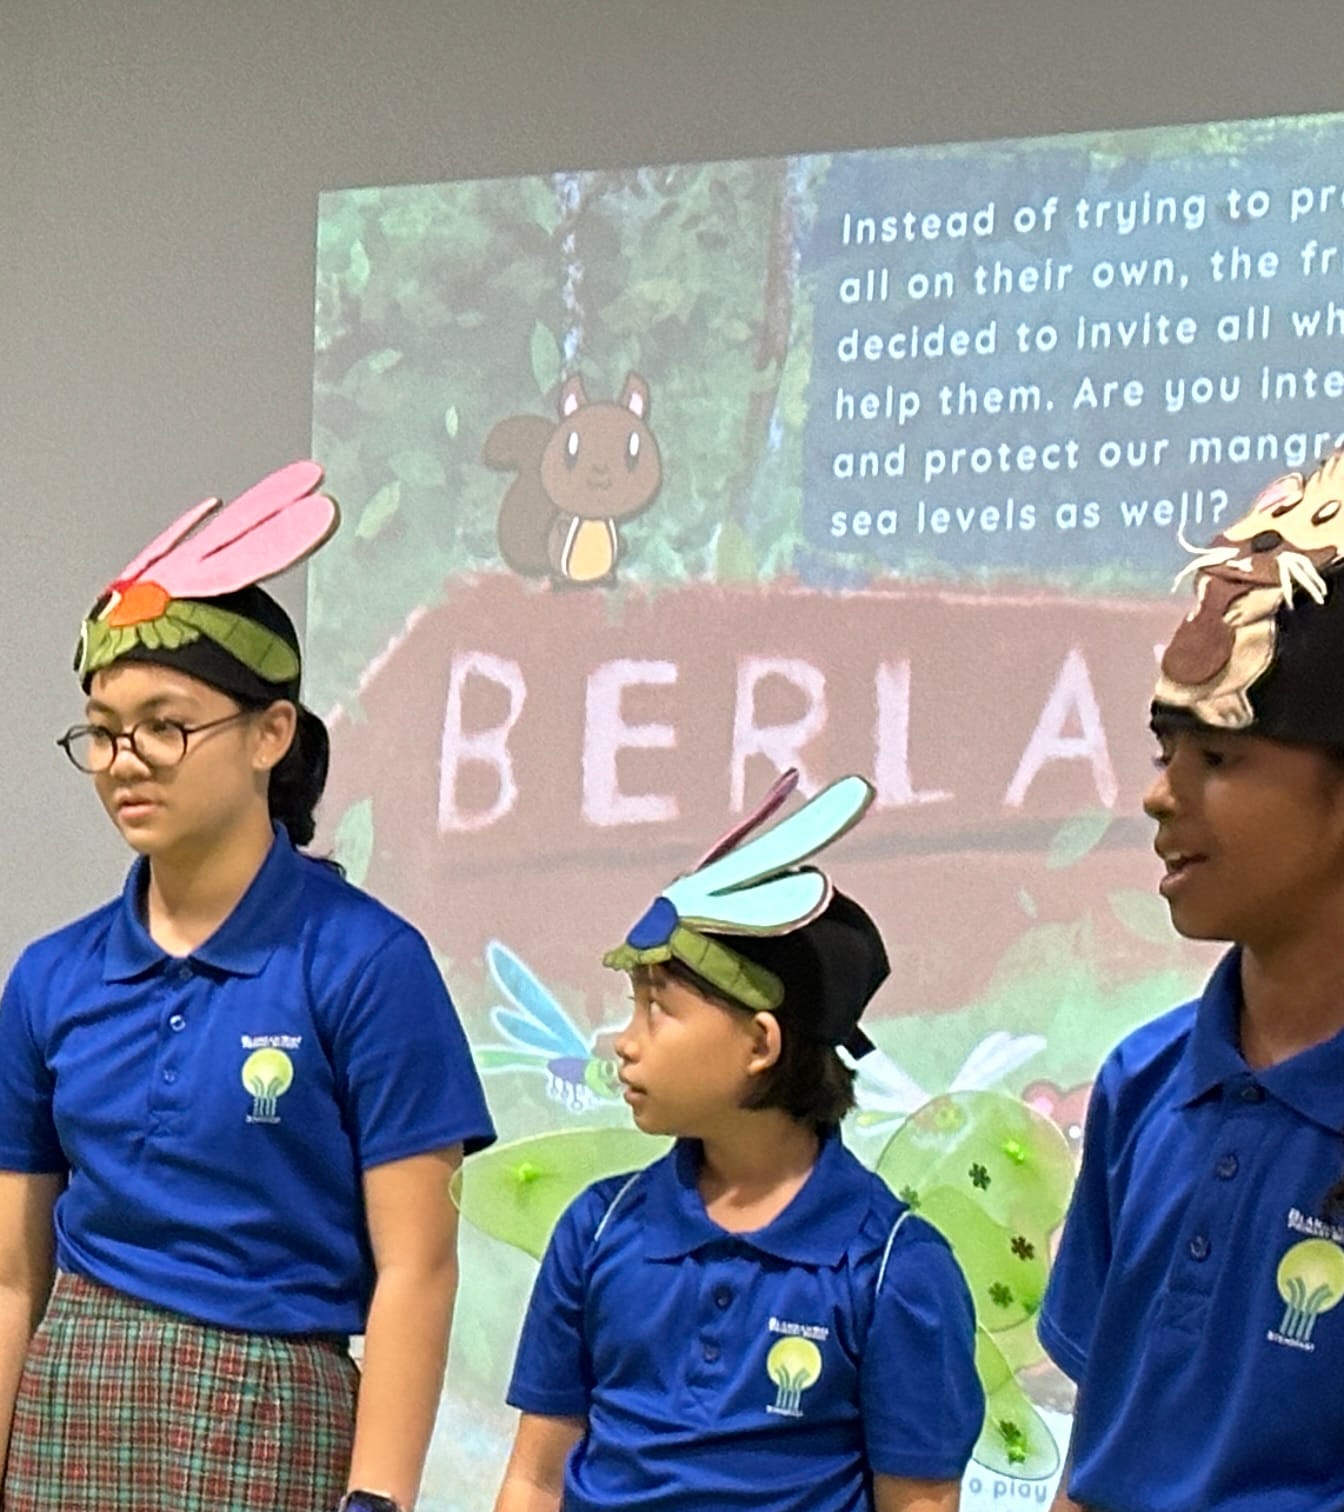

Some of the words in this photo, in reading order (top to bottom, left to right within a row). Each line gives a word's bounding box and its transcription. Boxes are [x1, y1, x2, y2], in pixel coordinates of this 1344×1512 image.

[843, 202, 994, 245] Instead
[1014, 196, 1058, 232] of
[1077, 190, 1205, 235] trying
[1227, 188, 1269, 220] to
[840, 269, 888, 303] all
[907, 271, 954, 299] on
[975, 259, 1072, 295] their
[1092, 257, 1188, 289] own,
[1211, 247, 1278, 281] the
[837, 321, 997, 363] decided
[1016, 321, 1058, 350] to
[1077, 311, 1197, 349] invite
[1217, 305, 1270, 342] all
[835, 386, 920, 425] help
[939, 382, 1054, 416] them.
[1073, 377, 1144, 409] Are
[1164, 376, 1240, 412] you
[1261, 366, 1344, 400] inte
[833, 444, 905, 478] and
[925, 439, 1079, 483] protect
[1099, 438, 1169, 468] our
[831, 509, 898, 537] sea
[917, 498, 1036, 534] levels
[1056, 500, 1100, 530] as
[1120, 490, 1228, 526] well?
[438, 645, 1165, 832] BERLA
[994, 1479, 1047, 1503] play
